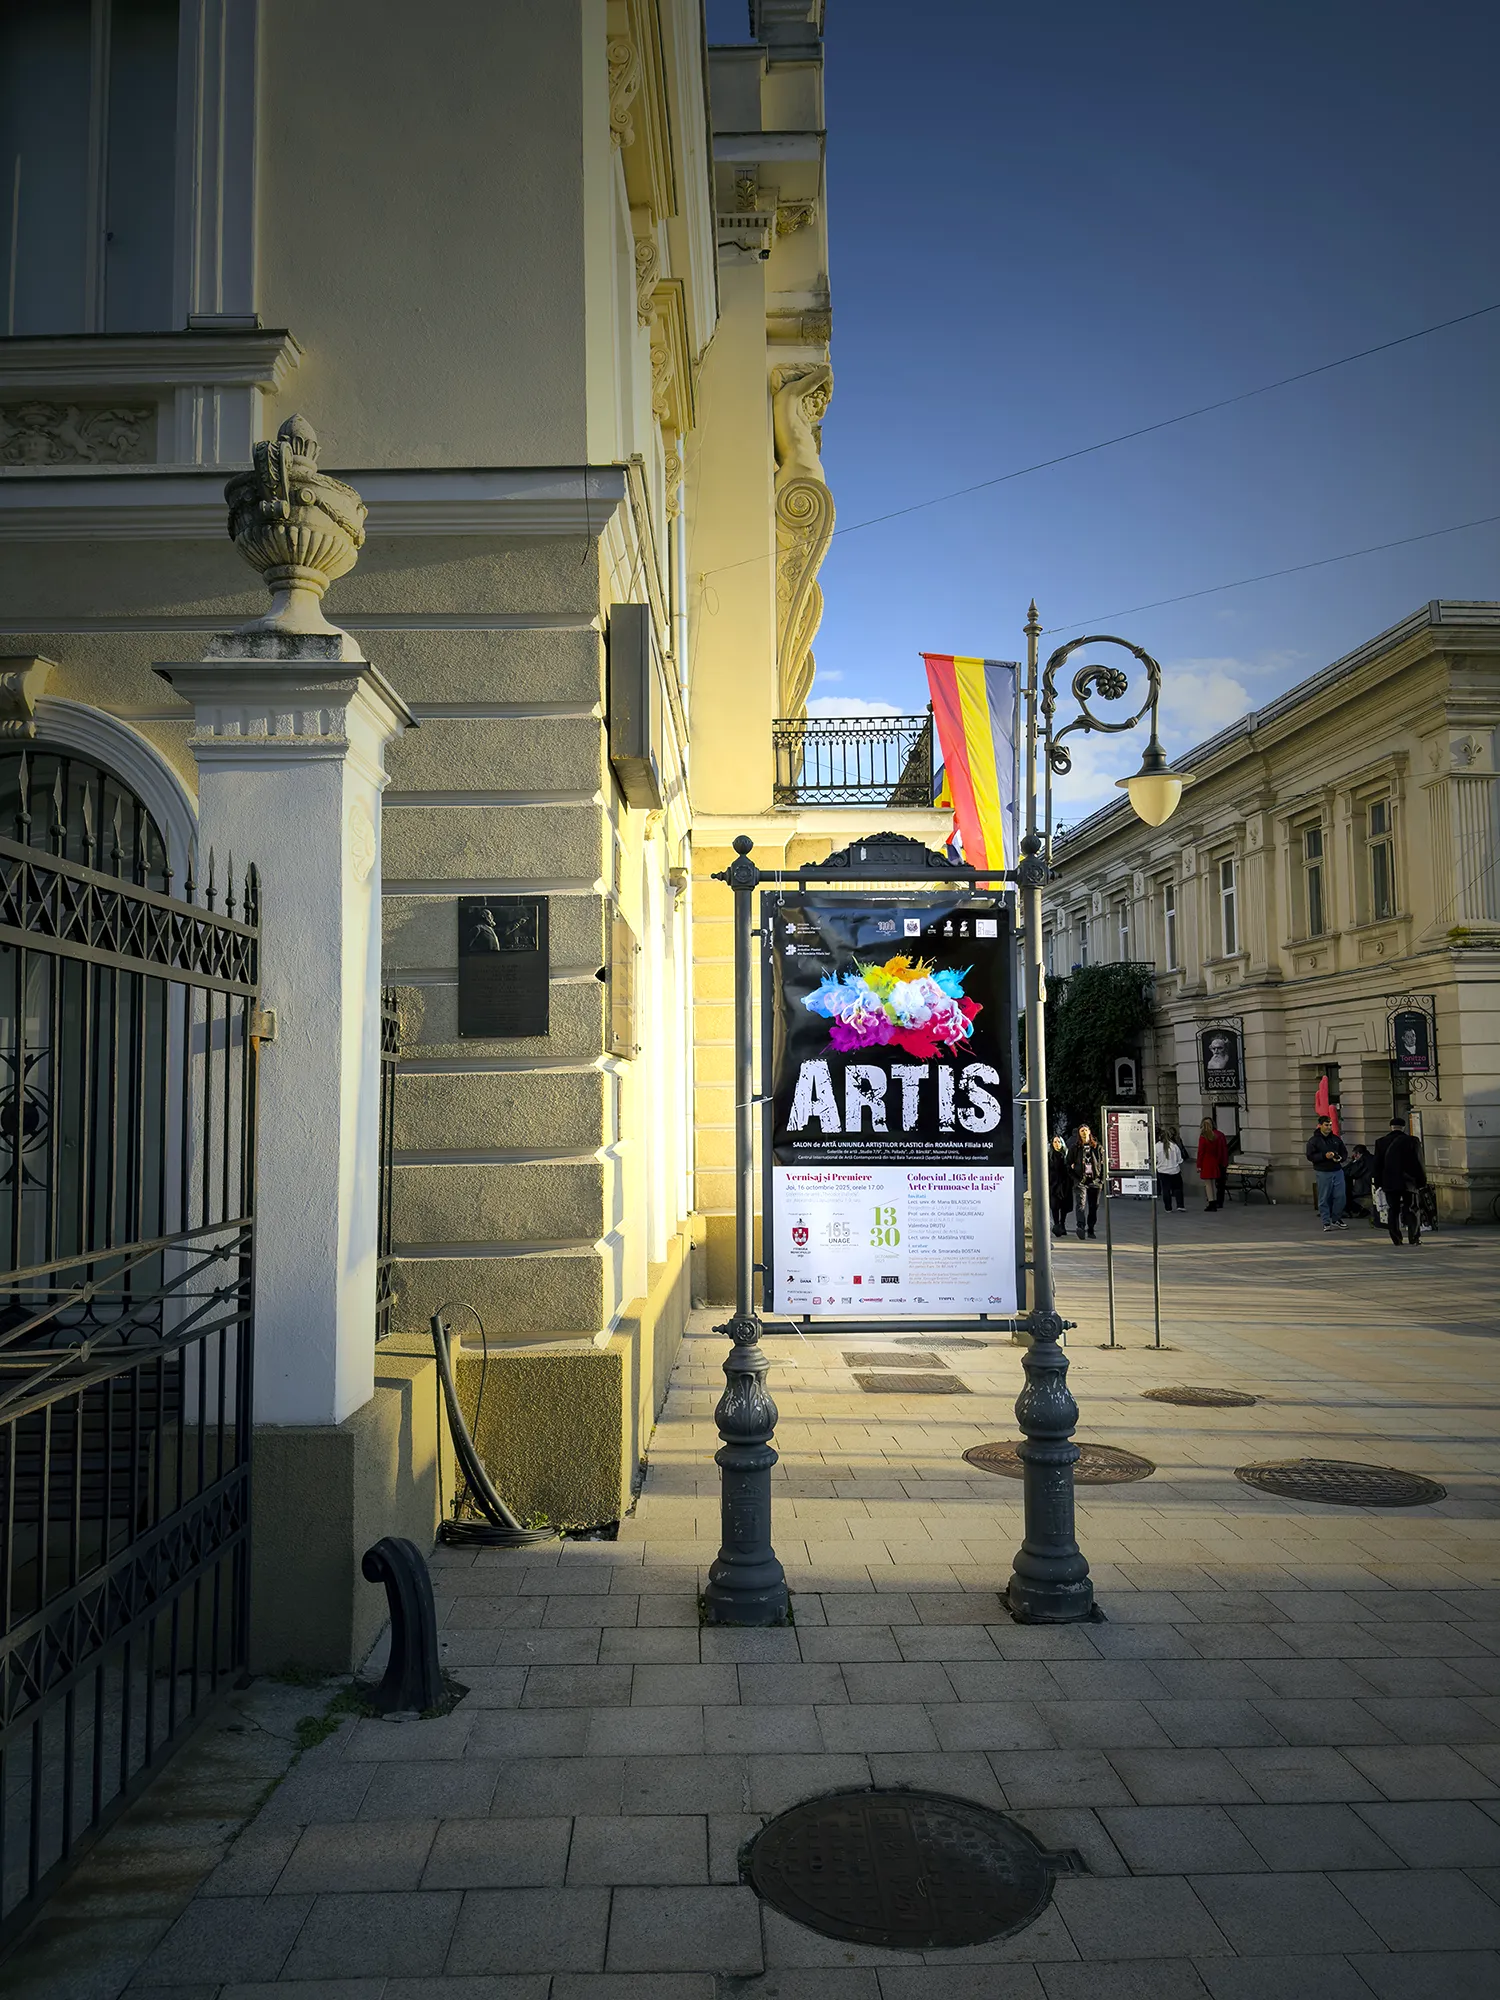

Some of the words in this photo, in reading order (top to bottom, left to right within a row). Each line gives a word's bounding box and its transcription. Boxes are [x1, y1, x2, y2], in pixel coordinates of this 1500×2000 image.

[787, 1059, 1002, 1133] ARTIS
[786, 1173, 822, 1183] Vernisaj
[823, 1173, 830, 1183] și
[832, 1173, 872, 1181] Premiere
[907, 1173, 946, 1181] Colocviul
[967, 1173, 978, 1181] de
[979, 1173, 993, 1181] ani
[994, 1173, 1005, 1181] de
[909, 1183, 927, 1191] Arte
[928, 1183, 970, 1191] Frumoase
[971, 1183, 979, 1191] la
[870, 1207, 897, 1226] 13
[870, 1227, 900, 1247] 30
